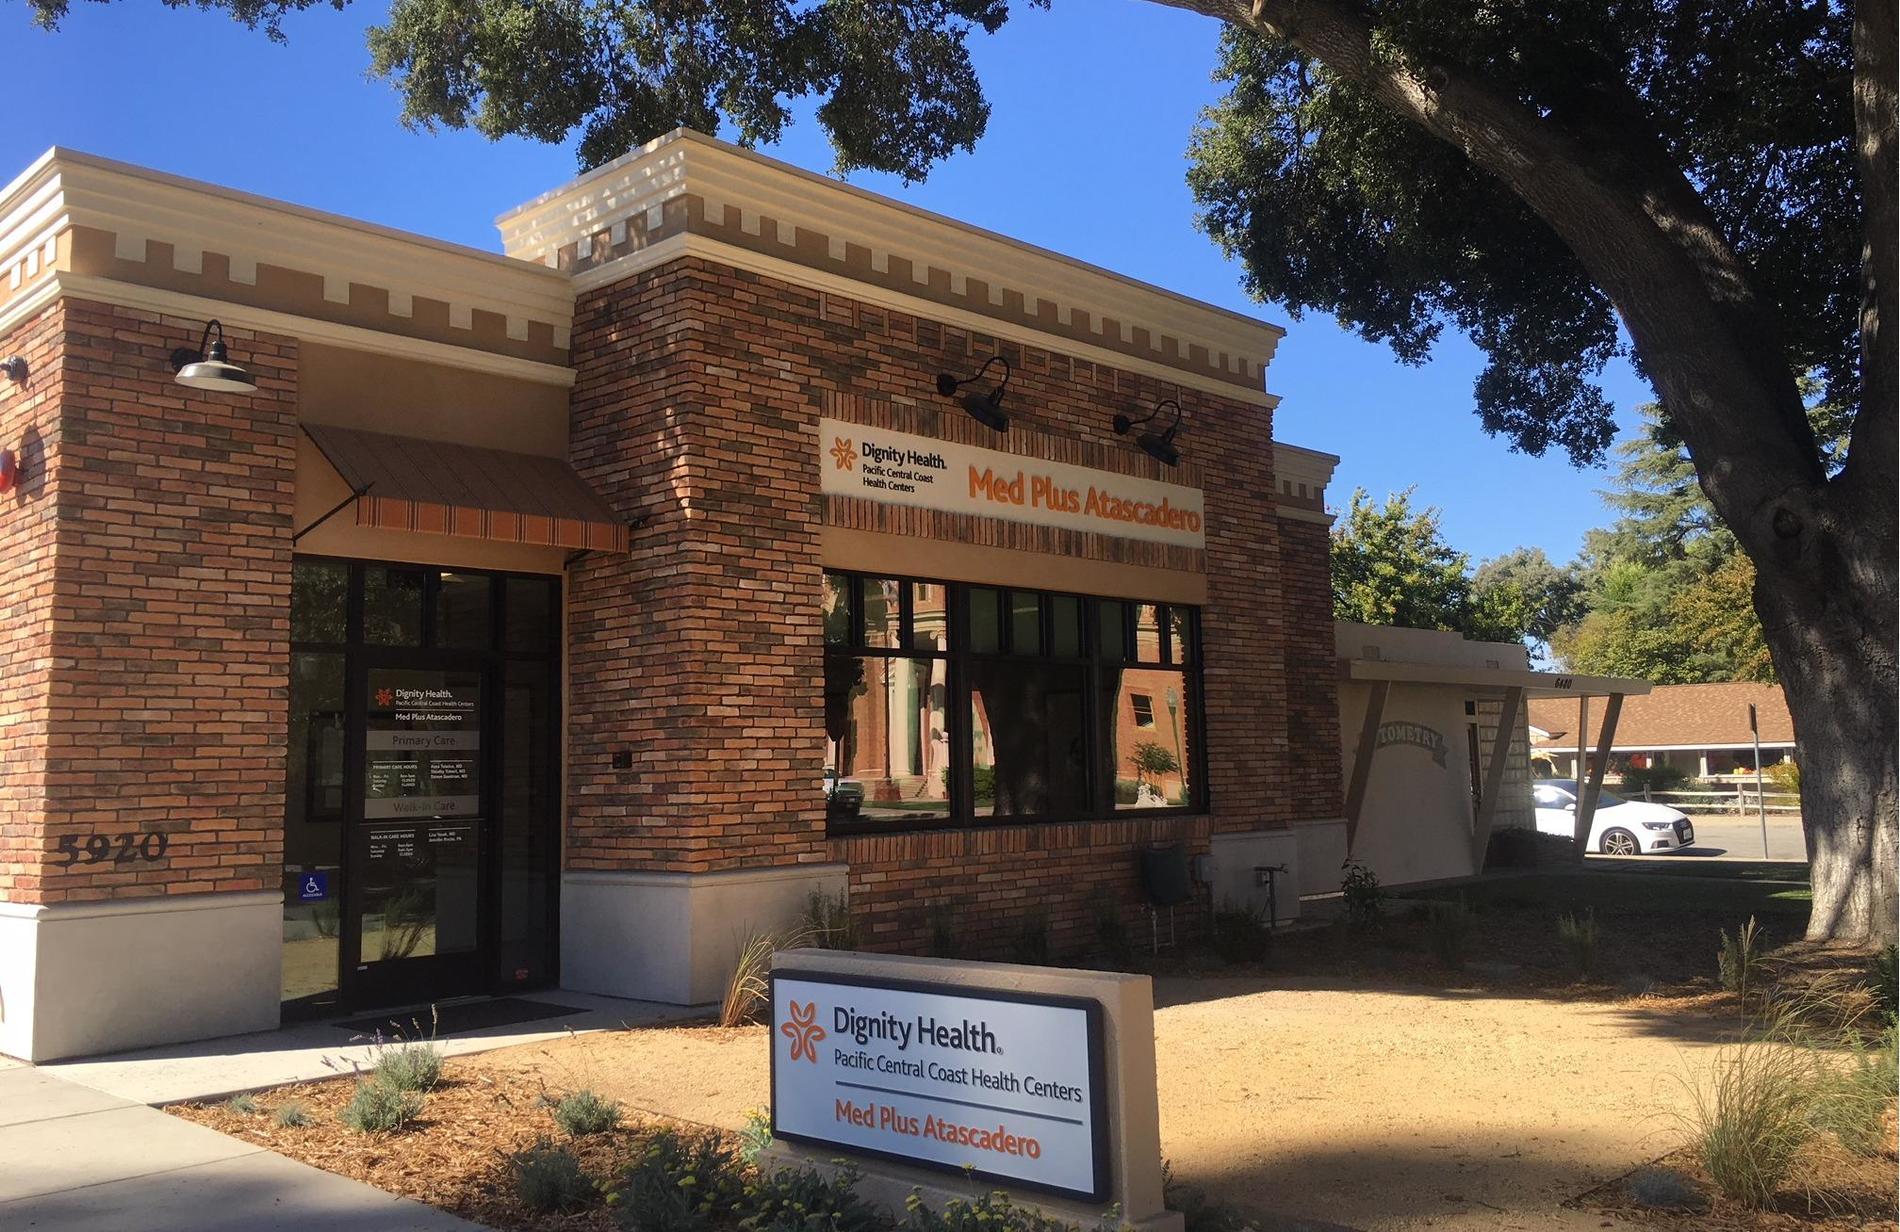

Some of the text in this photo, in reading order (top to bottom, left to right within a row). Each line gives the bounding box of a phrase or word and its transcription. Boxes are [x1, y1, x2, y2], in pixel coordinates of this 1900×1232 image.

[862, 442, 905, 466] Dignity
[862, 463, 934, 483] Pacific Central Coast
[863, 477, 915, 493] Health Centers
[968, 463, 1201, 532] Med Plus Atascadero
[396, 689, 424, 699] Dignity
[392, 735, 456, 747] Primary Care
[1377, 725, 1440, 748] TOMETRY
[435, 801, 455, 810] Care
[55, 832, 168, 867] 5920
[833, 1006, 912, 1051] Dignity
[834, 1048, 1082, 1103] Pacific Central Coast Health Centers
[835, 1098, 1041, 1159] Med Plus Atascadero
